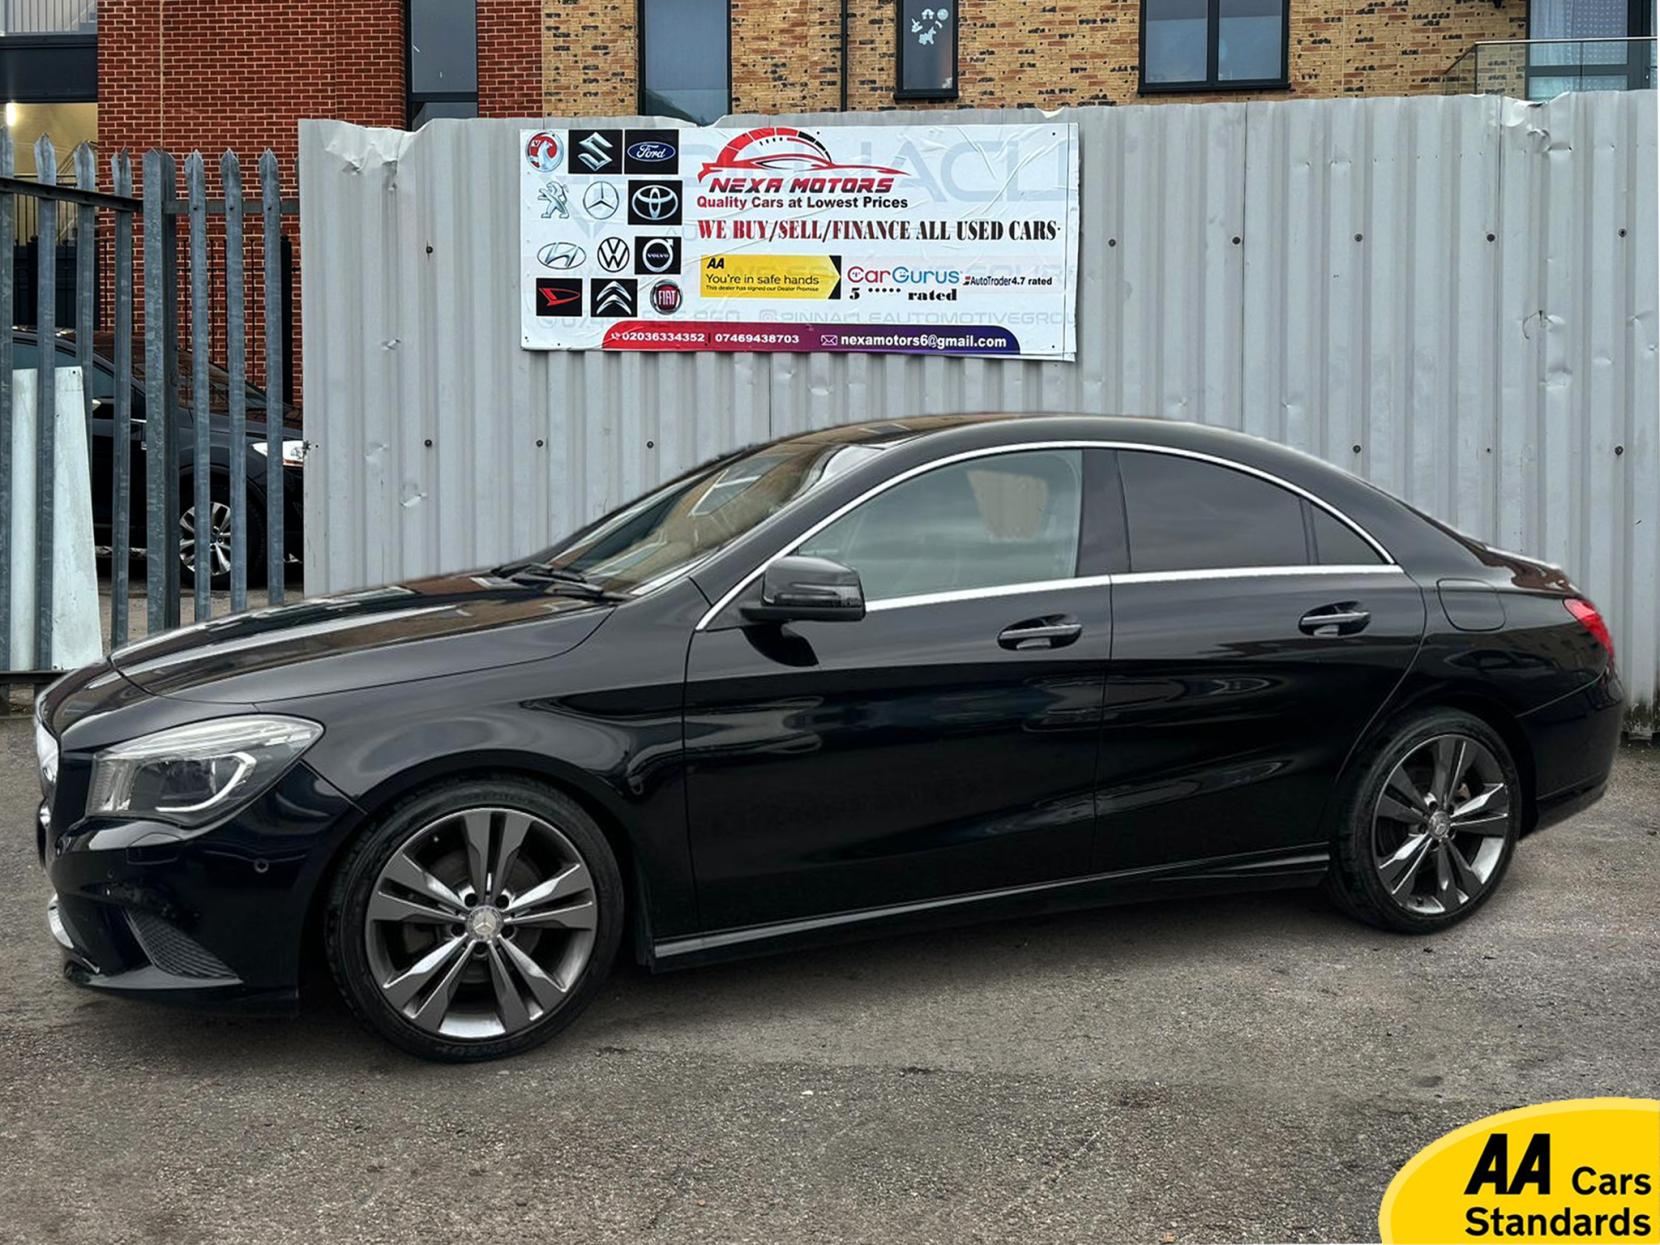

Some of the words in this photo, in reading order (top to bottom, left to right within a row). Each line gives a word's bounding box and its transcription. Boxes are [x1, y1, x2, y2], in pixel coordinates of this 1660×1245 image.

[636, 144, 666, 159] Ford
[709, 178, 784, 194] NEXA
[789, 178, 894, 194] MOTORS
[697, 196, 747, 210] Quality
[751, 196, 784, 209] Cars
[788, 197, 803, 209] at
[807, 196, 859, 209] Lowest
[863, 196, 908, 209] Prices
[698, 220, 727, 239] WE
[916, 220, 951, 240] ALL
[957, 220, 1004, 241] USED
[706, 257, 725, 270] AA
[706, 273, 741, 284] You're
[744, 274, 754, 285] in
[757, 273, 782, 286] safe
[784, 274, 820, 286] hands
[847, 266, 960, 284] CarGurus
[1028, 277, 1053, 286] rated
[658, 290, 677, 306] FIAT
[849, 287, 860, 301] 5
[908, 287, 957, 301] rated
[621, 332, 706, 344] 02036334352
[715, 333, 800, 345] 07469438703
[840, 334, 1008, 349] nexamotors6@gmail.com
